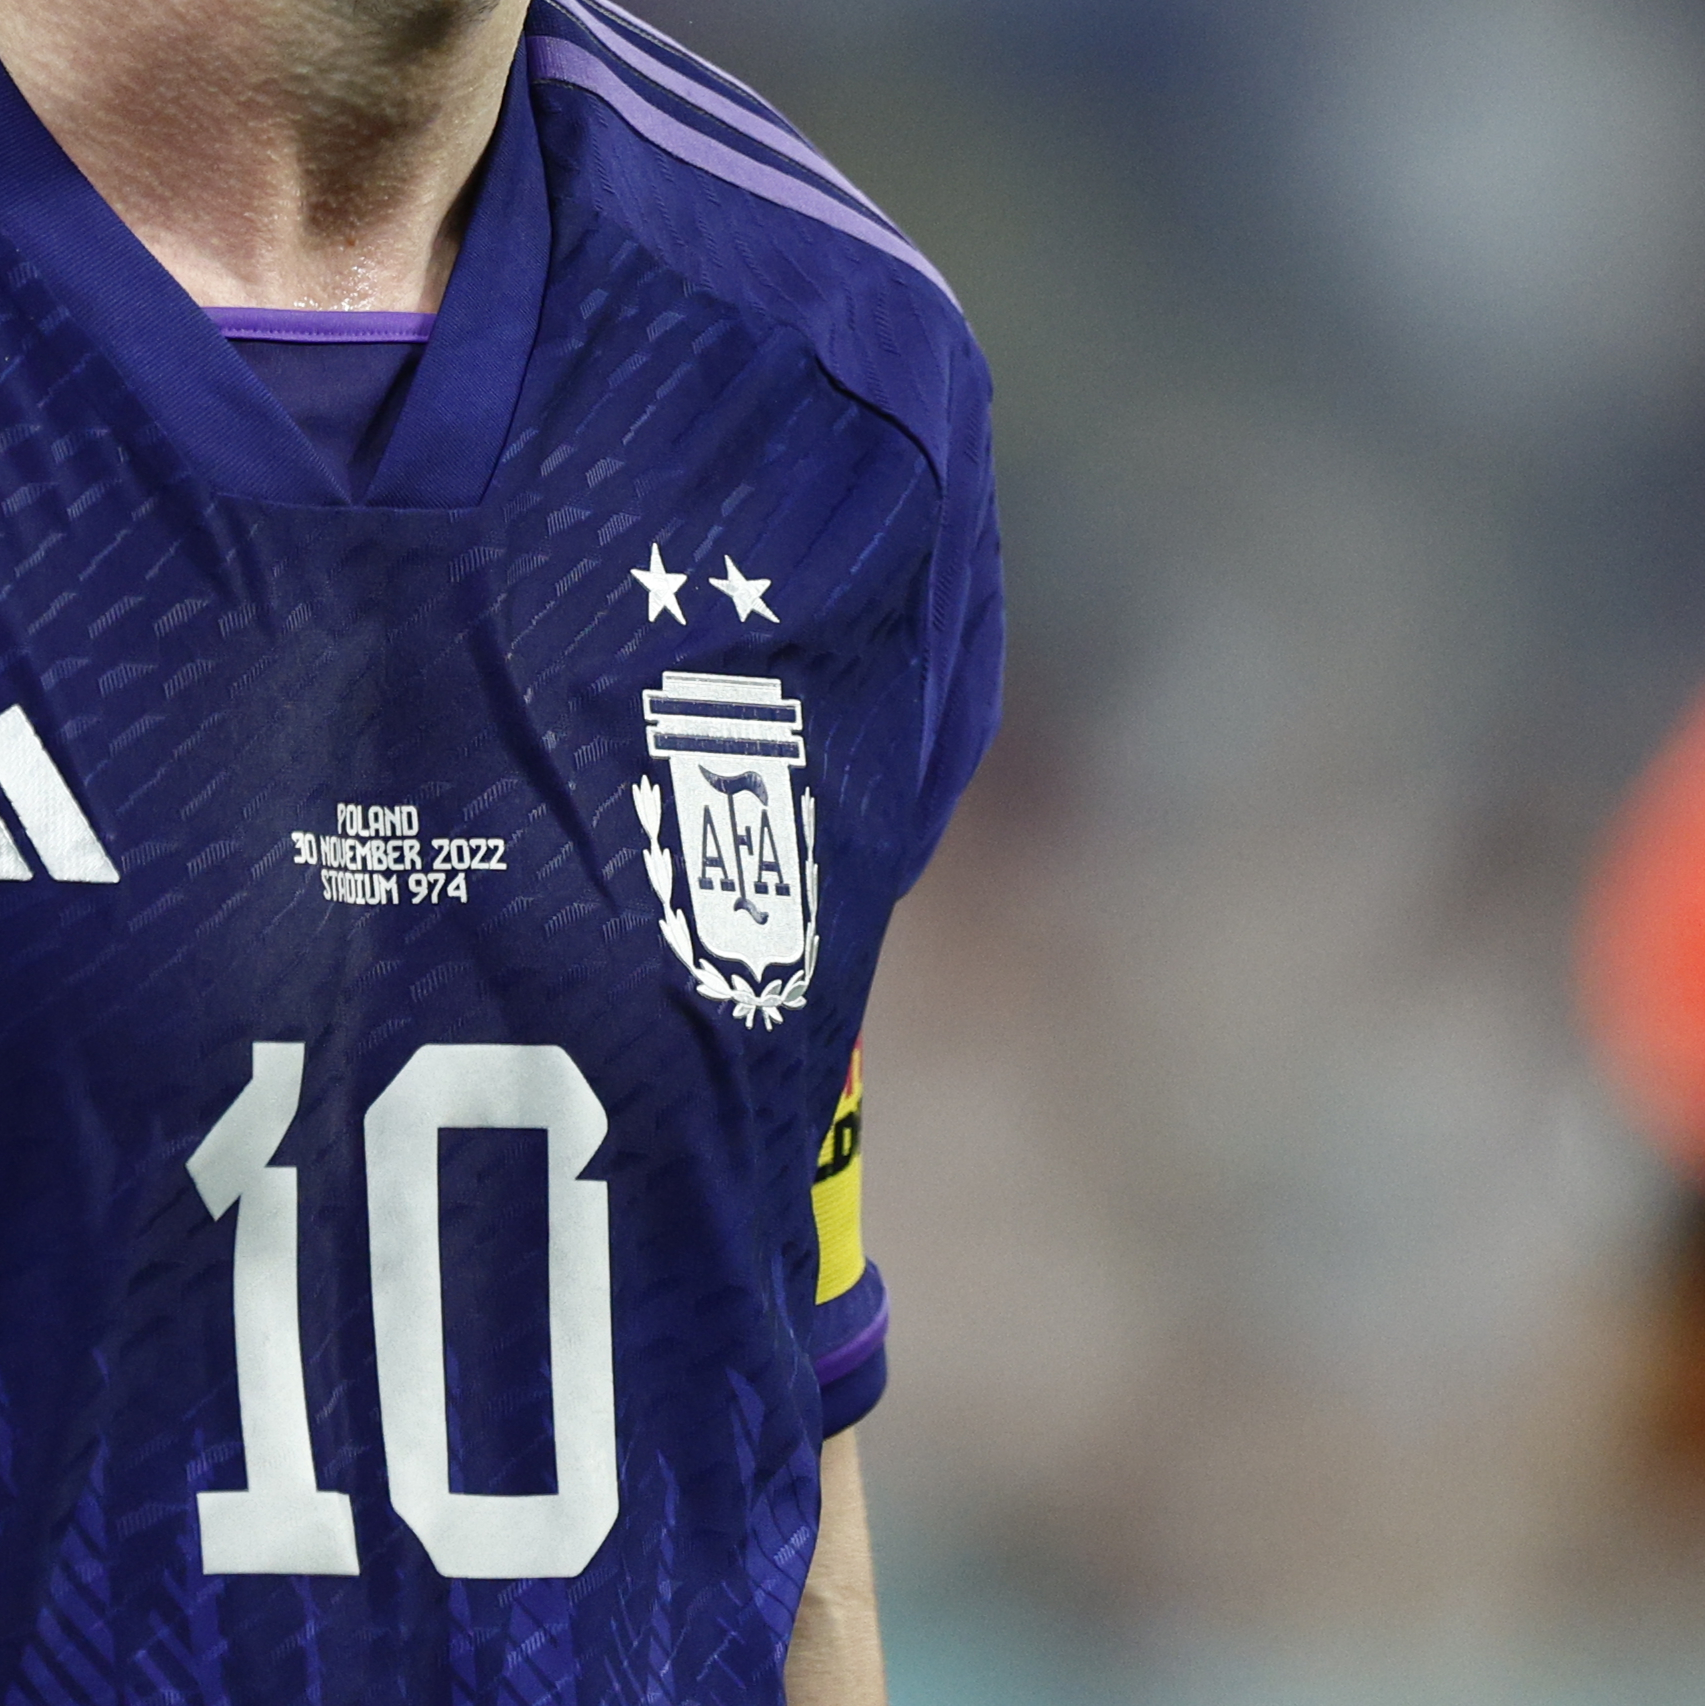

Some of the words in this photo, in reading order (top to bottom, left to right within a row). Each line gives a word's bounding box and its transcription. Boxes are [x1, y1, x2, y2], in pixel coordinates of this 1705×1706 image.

[336, 802, 419, 837] POLAND
[291, 831, 318, 865] 30
[320, 835, 422, 871] NOVEMBER
[431, 838, 507, 870] 2022
[697, 763, 791, 925] AFA
[321, 869, 398, 905] STADIUM
[408, 872, 467, 904] 974
[185, 1041, 619, 1579] 10
